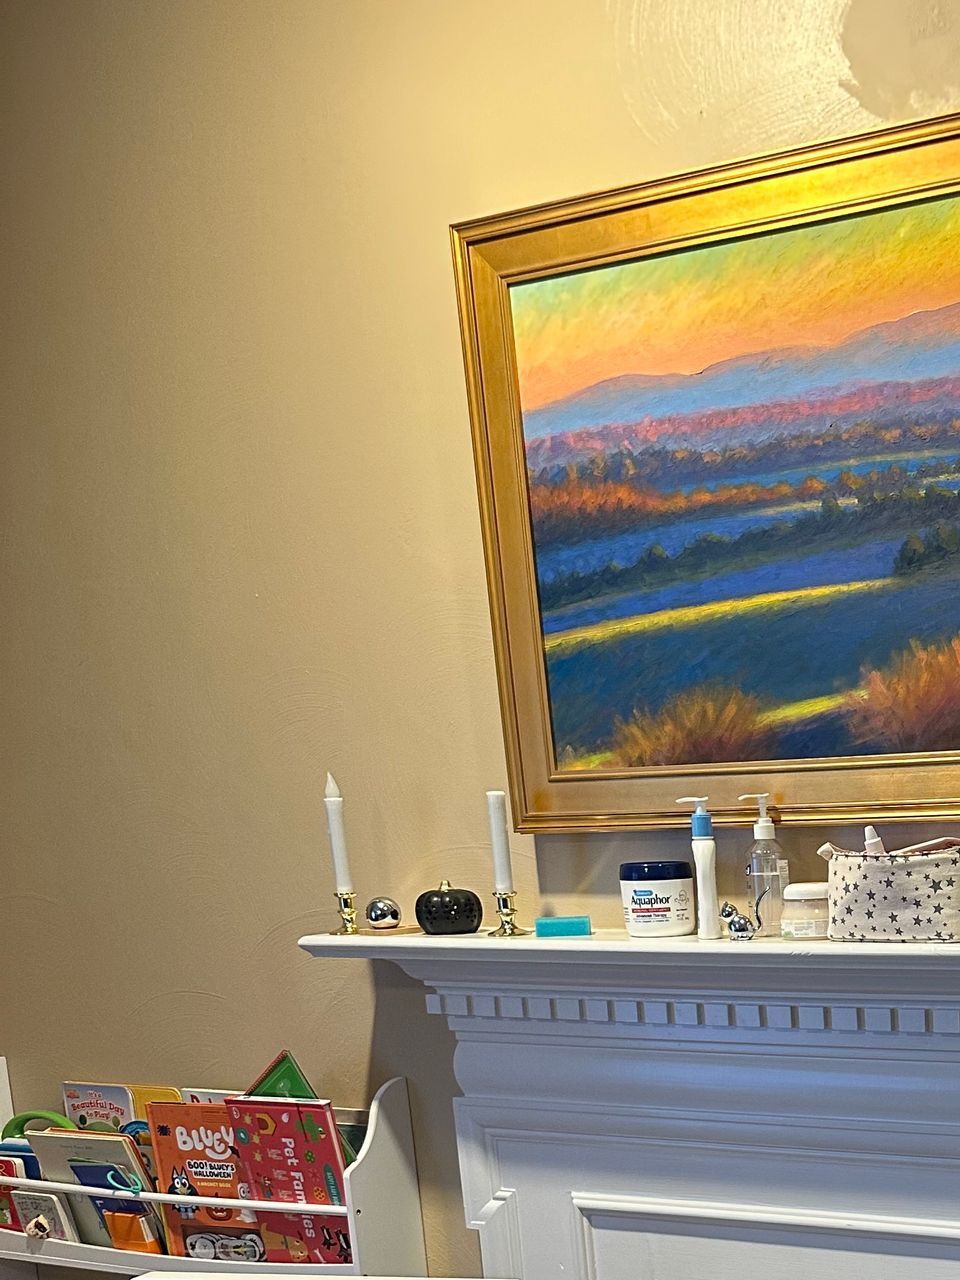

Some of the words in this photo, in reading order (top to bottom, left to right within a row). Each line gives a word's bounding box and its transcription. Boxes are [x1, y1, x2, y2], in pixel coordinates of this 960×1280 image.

[631, 894, 672, 908] Aquaphor
[71, 1099, 107, 1111] Beautiful
[109, 1102, 125, 1116] Day
[282, 1137, 299, 1166] Pet
[187, 1161, 208, 1169] BOO!
[193, 1170, 231, 1178] HALLOWEEN
[290, 1171, 316, 1238] Famies
